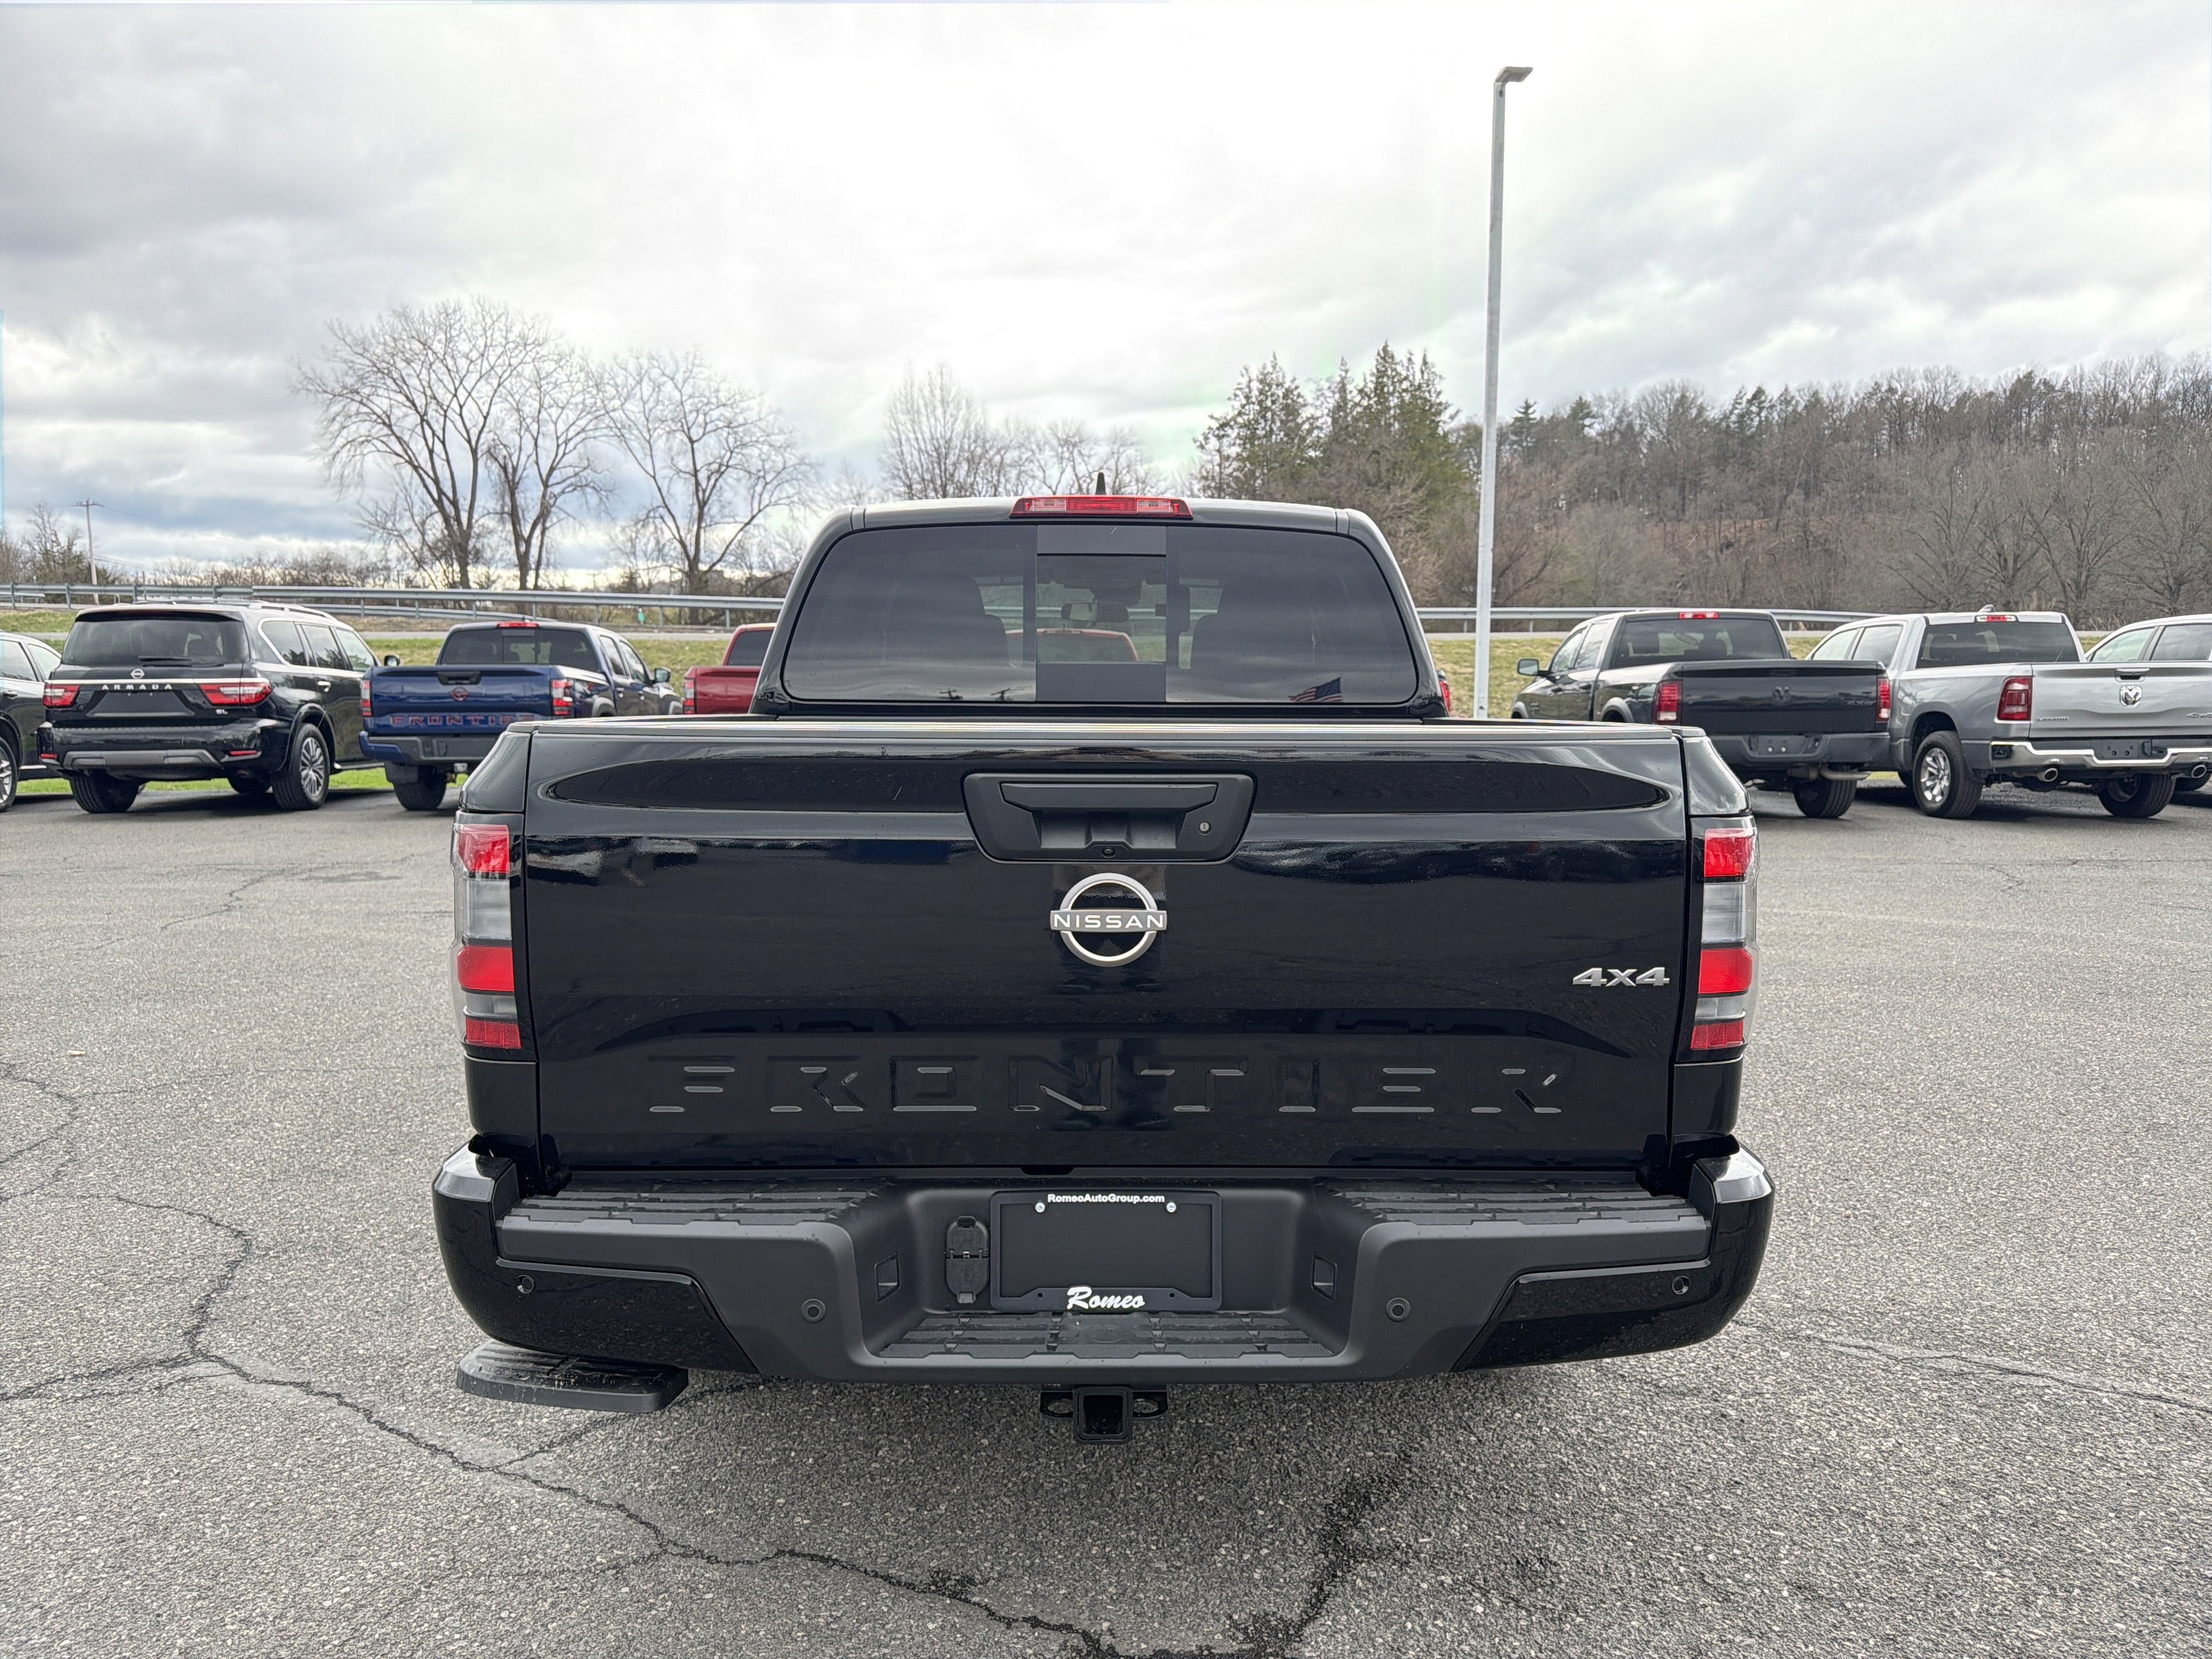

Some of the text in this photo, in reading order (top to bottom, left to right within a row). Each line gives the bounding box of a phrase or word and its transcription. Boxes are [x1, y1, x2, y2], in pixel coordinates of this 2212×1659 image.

[1054, 914, 1164, 928] NISSAN
[647, 1054, 1565, 1113] FRONTIER
[1047, 1193, 1165, 1204] RomeoAutoGroup.com
[1066, 1285, 1146, 1310] Romeo
